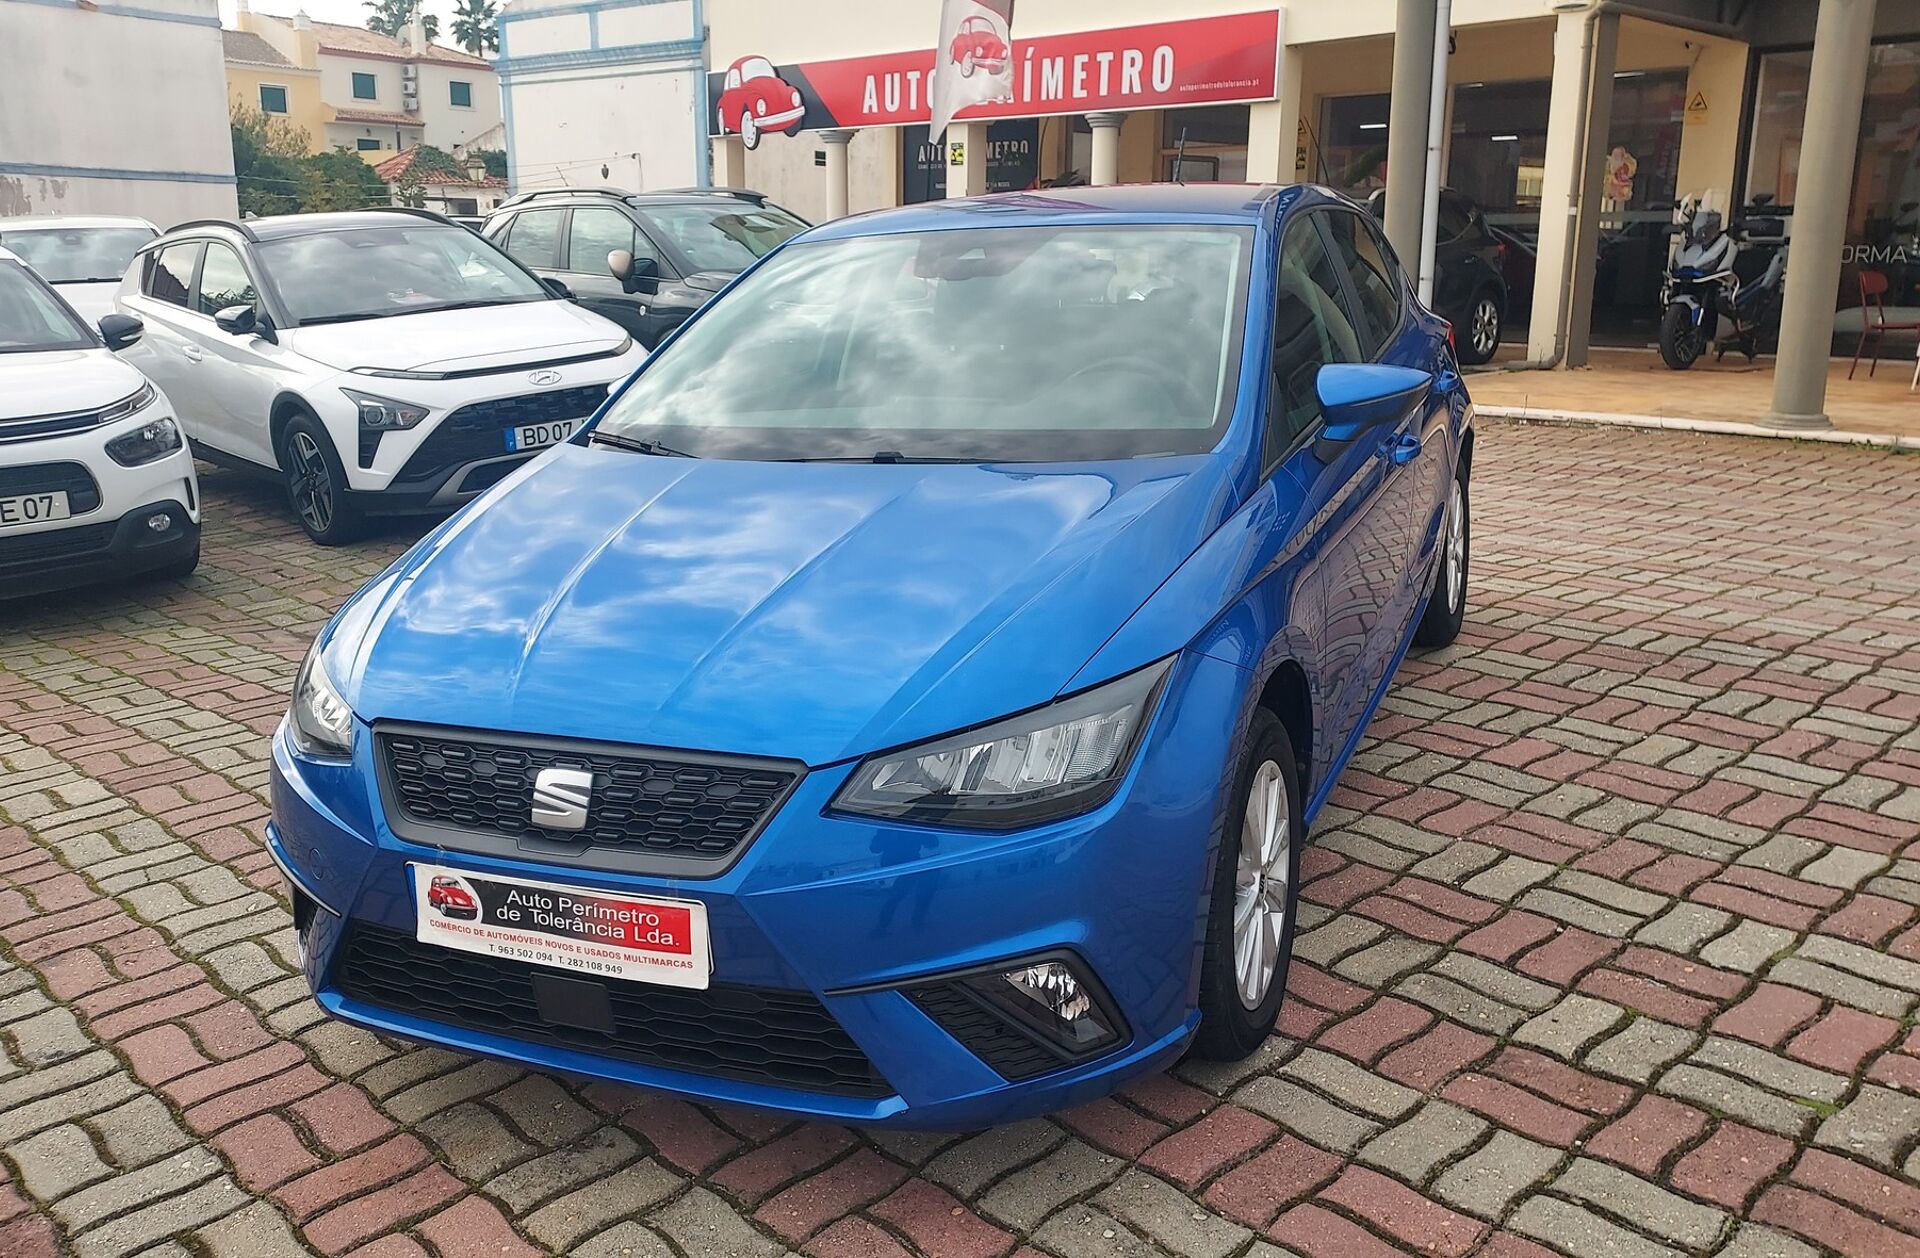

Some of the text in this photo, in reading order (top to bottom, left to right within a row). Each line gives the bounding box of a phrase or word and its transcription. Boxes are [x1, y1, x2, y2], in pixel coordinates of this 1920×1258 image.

[975, 45, 1175, 106] ÍMETRO
[918, 144, 947, 162] AUT
[523, 427, 549, 447] BD
[552, 421, 572, 442] 07
[23, 495, 53, 520] 07
[507, 889, 660, 927] Auto Perímetro
[496, 905, 680, 946] de Tolerância Lda.
[430, 919, 693, 969] COMÉRCIO DE AUTOMÓVEIS NOVOS E USADOS MULTIMARCAS
[488, 944, 623, 975] T. 963 502 094 T. 282 108 949
